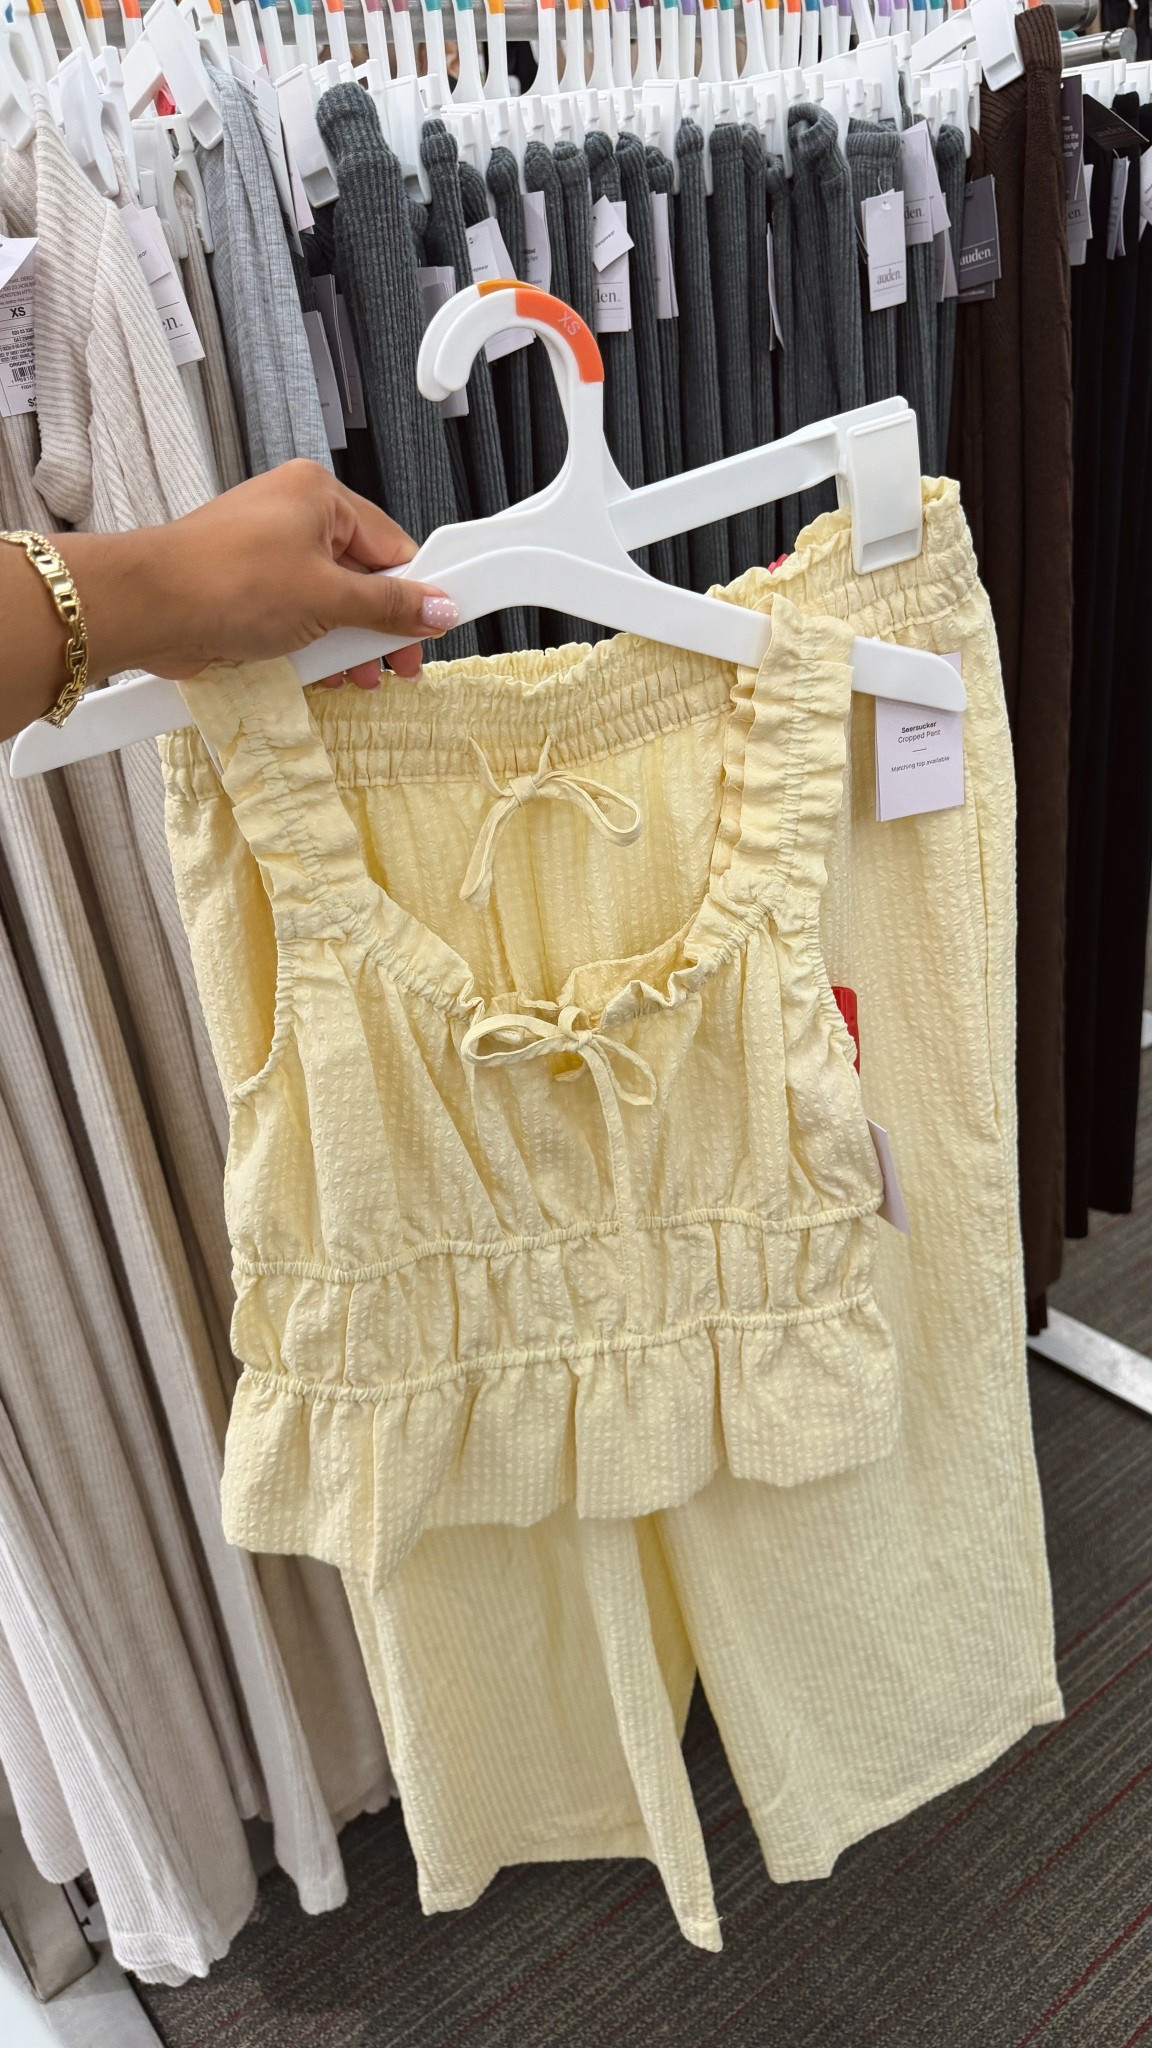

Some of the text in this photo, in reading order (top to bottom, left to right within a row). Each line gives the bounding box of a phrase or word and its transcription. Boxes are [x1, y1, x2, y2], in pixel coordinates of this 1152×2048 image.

[10, 306, 26, 318] XS
[558, 312, 580, 336] XS
[902, 722, 936, 734] Seersucker
[898, 730, 940, 744] Cropped Pant
[892, 763, 916, 772] Matching
[926, 756, 950, 765] available
